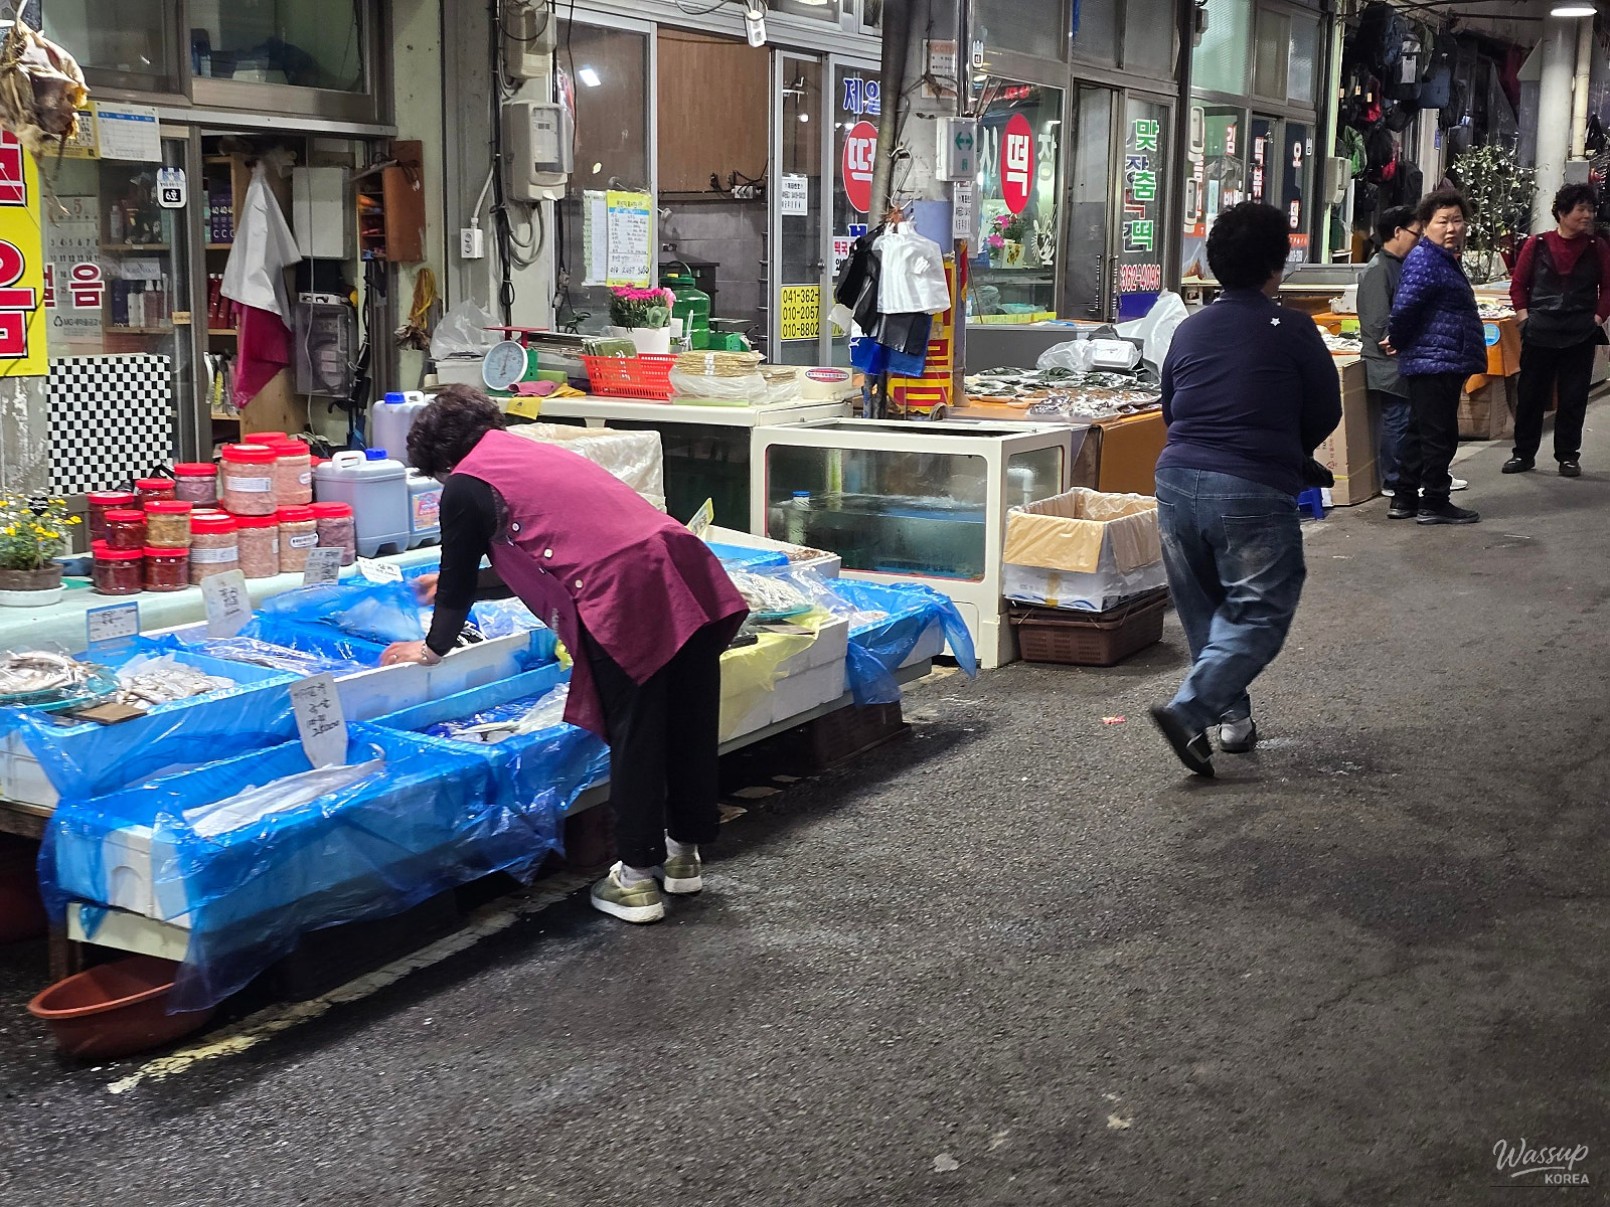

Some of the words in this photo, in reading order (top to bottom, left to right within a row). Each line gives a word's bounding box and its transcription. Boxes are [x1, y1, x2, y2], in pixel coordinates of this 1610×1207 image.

[782, 289, 819, 304] 041-362-
[782, 306, 819, 321] 010-2057
[782, 323, 819, 338] 010-8802
